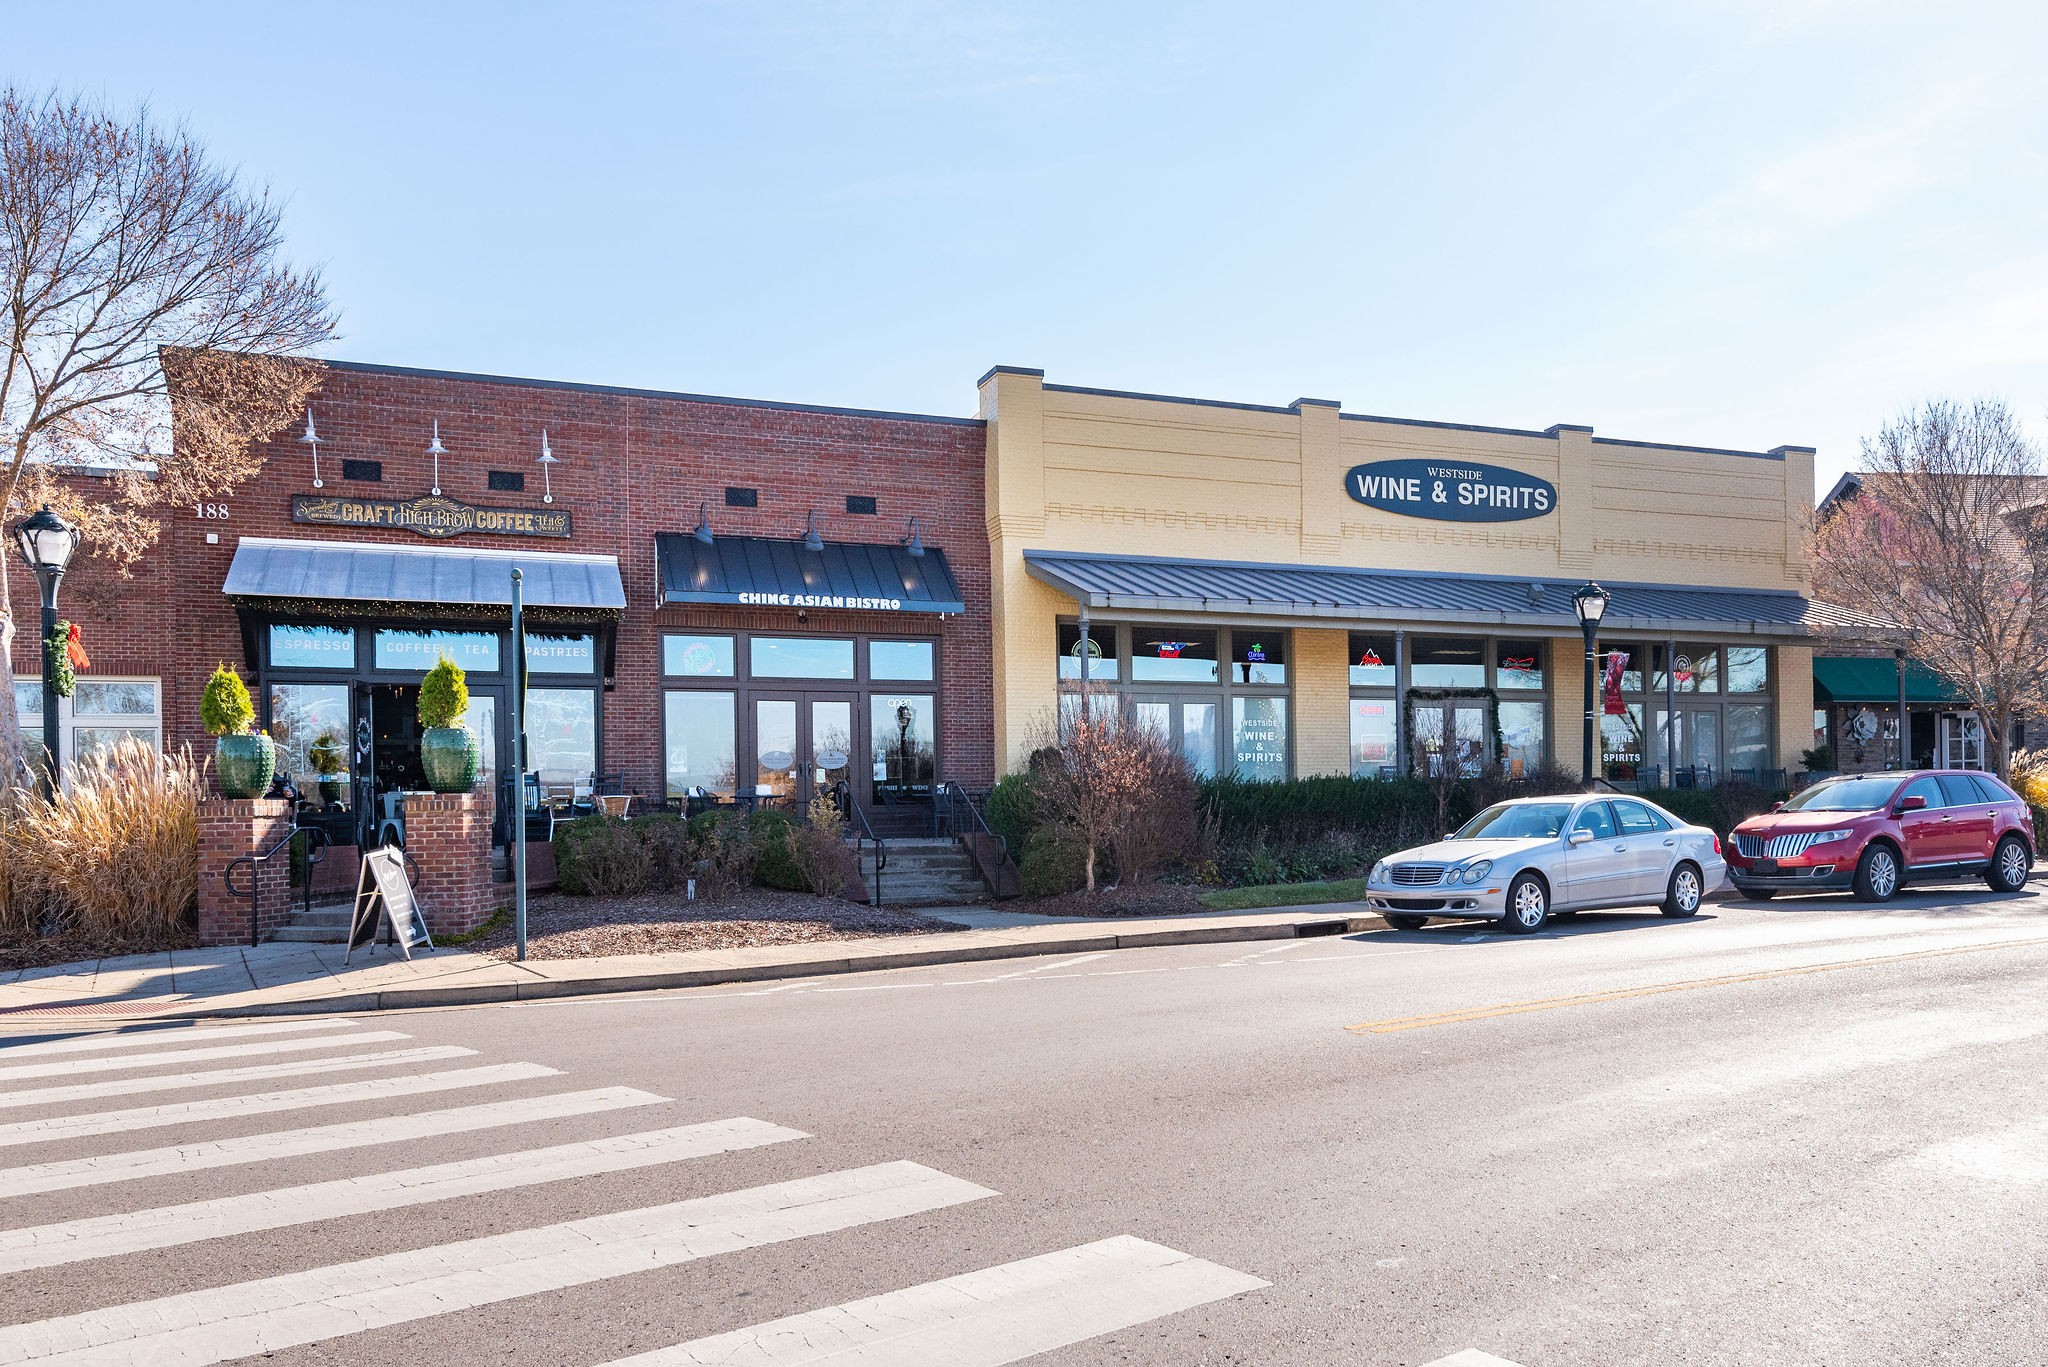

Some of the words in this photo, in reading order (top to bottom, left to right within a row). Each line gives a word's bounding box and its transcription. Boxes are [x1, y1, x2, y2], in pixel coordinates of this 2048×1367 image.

[1427, 467, 1482, 481] WESTSIDE
[1357, 475, 1421, 501] WINE
[1431, 480, 1448, 503] &
[1458, 483, 1549, 511] SPIRITS
[196, 503, 230, 519] 188
[341, 503, 394, 523] CRAFT
[395, 503, 432, 526] HIGH
[432, 506, 475, 528] BROW
[476, 510, 534, 530] COFFEE
[739, 593, 790, 605] CHING
[793, 595, 845, 607] ASIAN
[846, 597, 901, 610] BISTRO
[275, 640, 350, 651] ESPRESSO
[386, 643, 440, 653] COFFEE
[464, 644, 489, 655] TEA
[526, 647, 588, 657] PASTRIES
[1244, 732, 1274, 741] WINE
[1609, 734, 1633, 743] WINE
[1255, 742, 1263, 751] &
[1618, 743, 1625, 752] &
[1237, 753, 1283, 762] SPIRITS
[1603, 753, 1641, 762] SPIRITS
